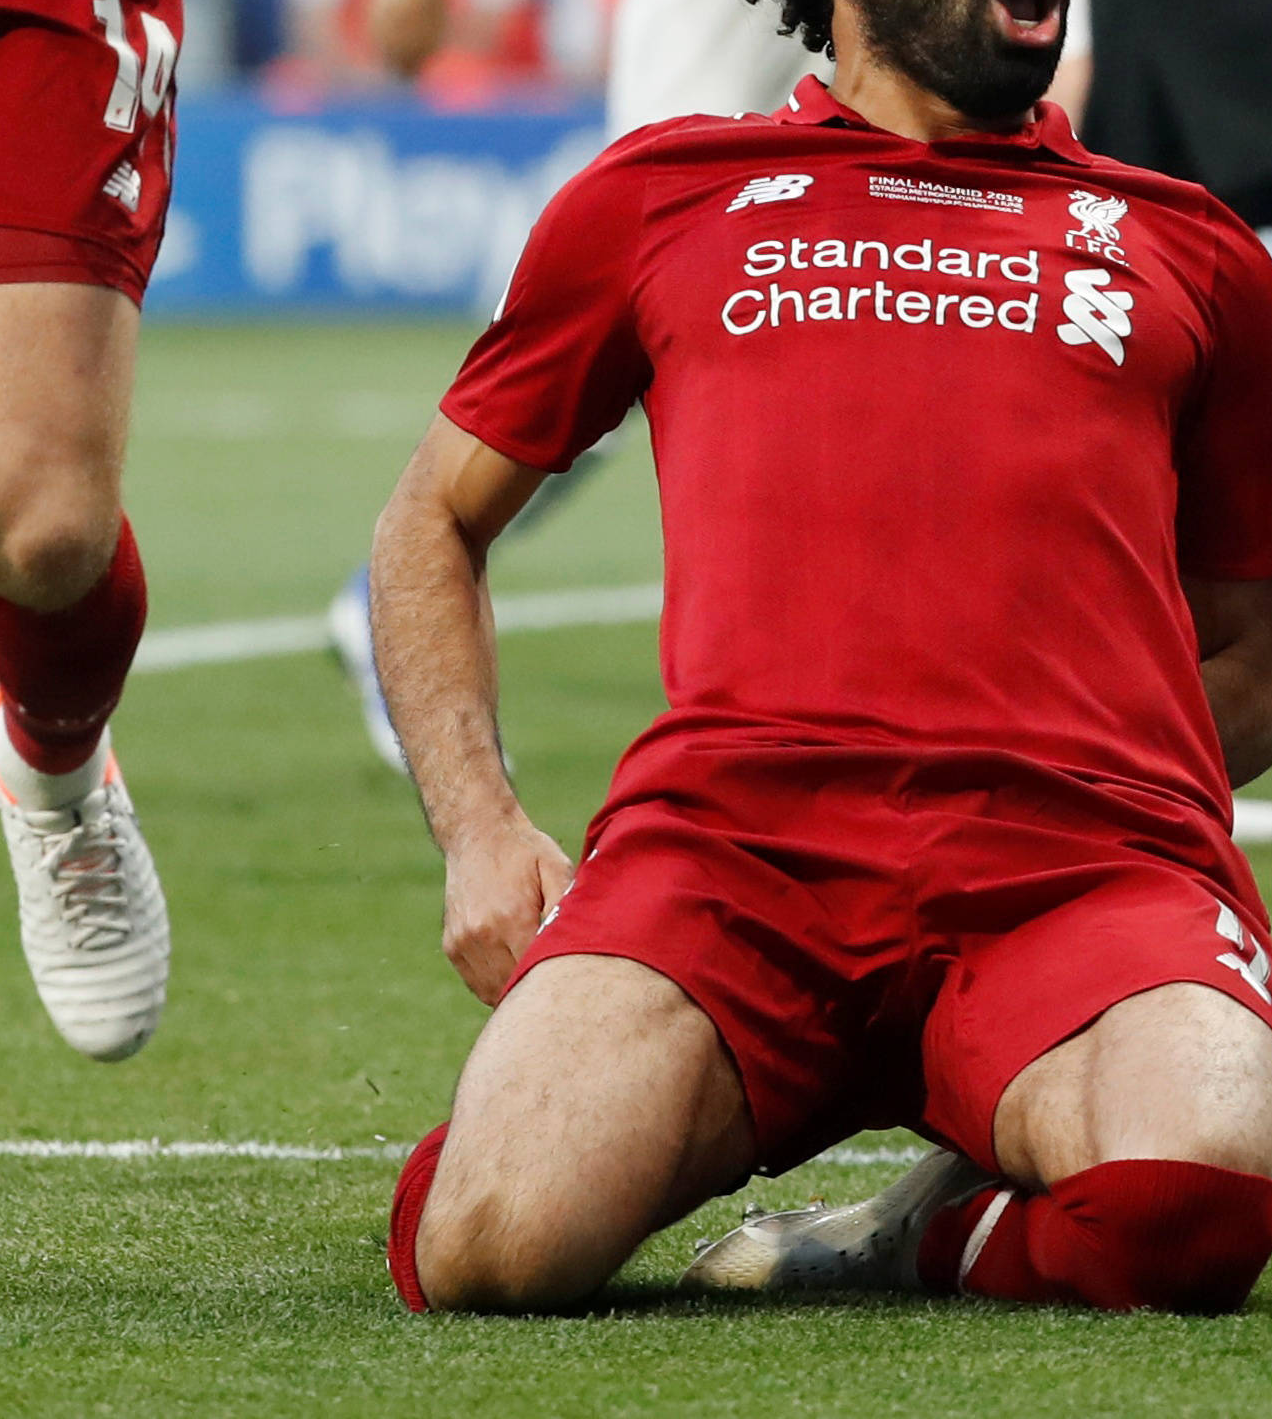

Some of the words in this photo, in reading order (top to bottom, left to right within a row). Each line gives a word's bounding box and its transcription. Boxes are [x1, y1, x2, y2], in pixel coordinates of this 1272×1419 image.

[869, 176, 917, 189] FINAL
[919, 180, 983, 197] MADRID
[986, 190, 1024, 204] 2019
[743, 237, 1040, 285] Standard
[721, 280, 1039, 336] Chartered
